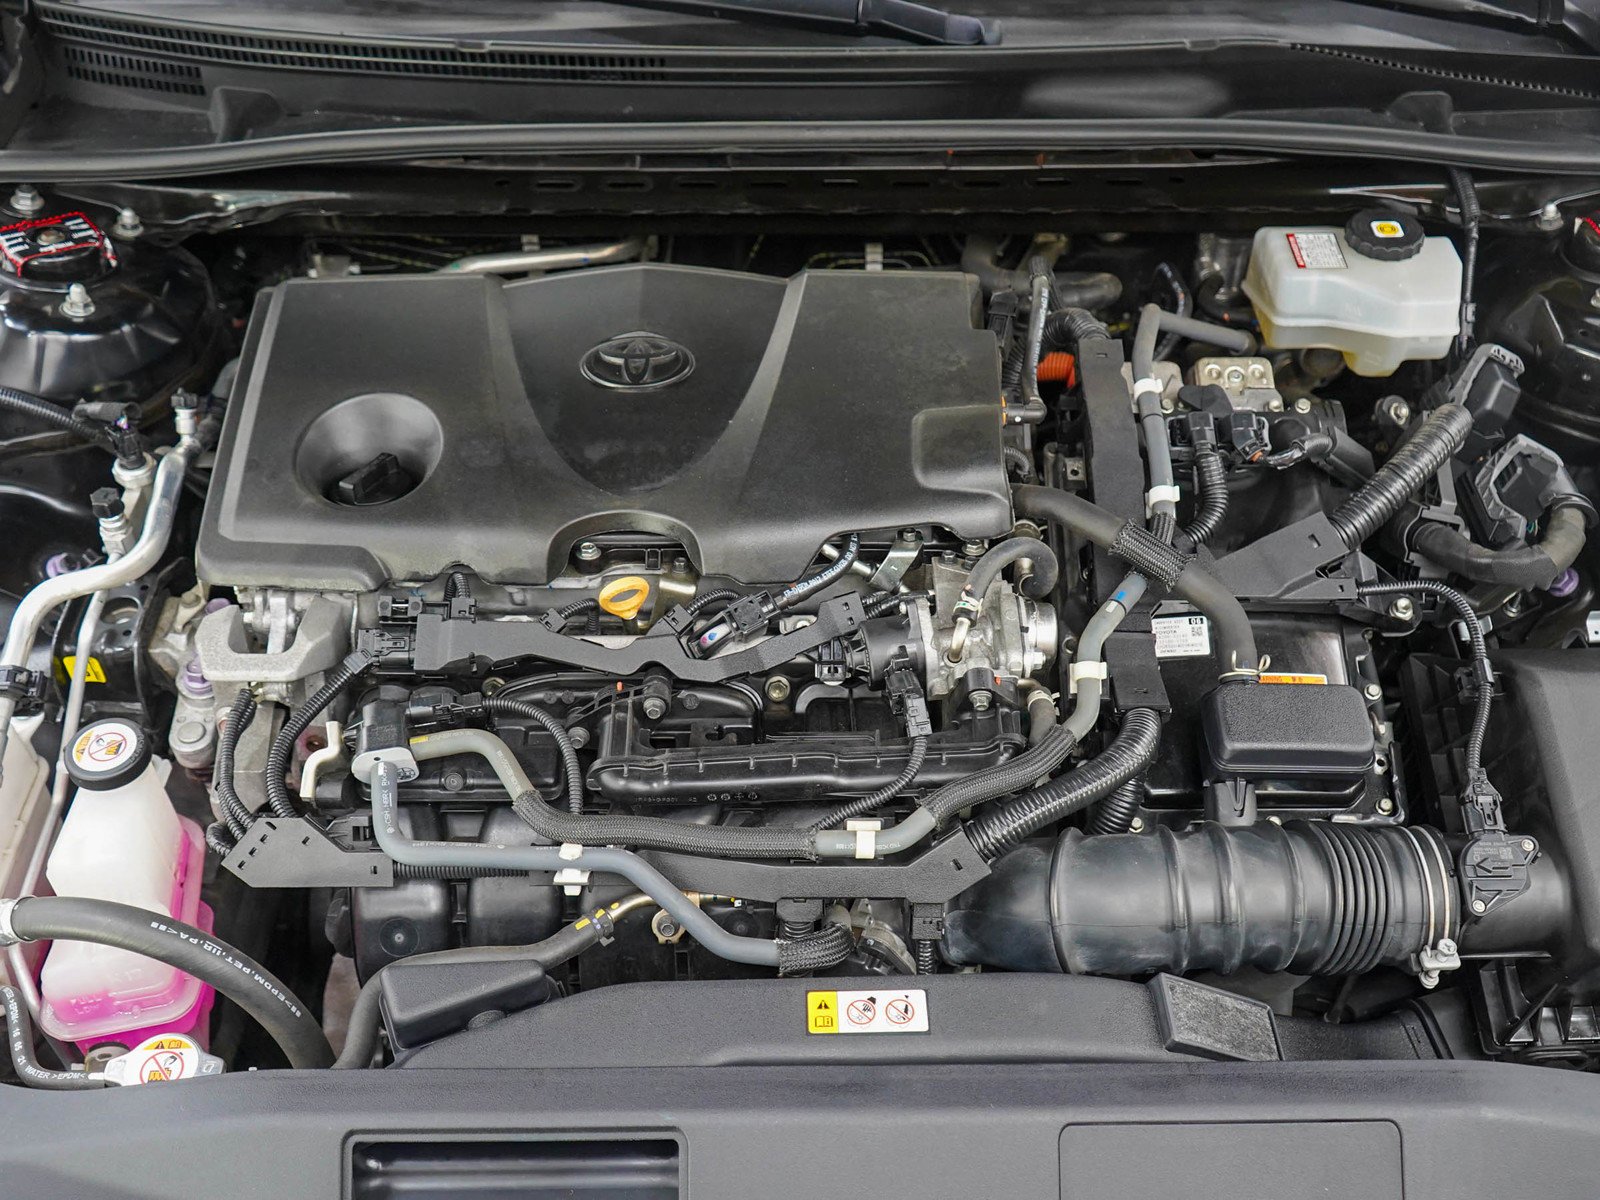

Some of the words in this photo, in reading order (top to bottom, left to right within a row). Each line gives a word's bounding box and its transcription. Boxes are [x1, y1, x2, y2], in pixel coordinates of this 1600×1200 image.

[12, 1029, 21, 1038] 16
[14, 1041, 23, 1051] 05
[17, 1055, 27, 1065] 21
[24, 1065, 51, 1080] WATER
